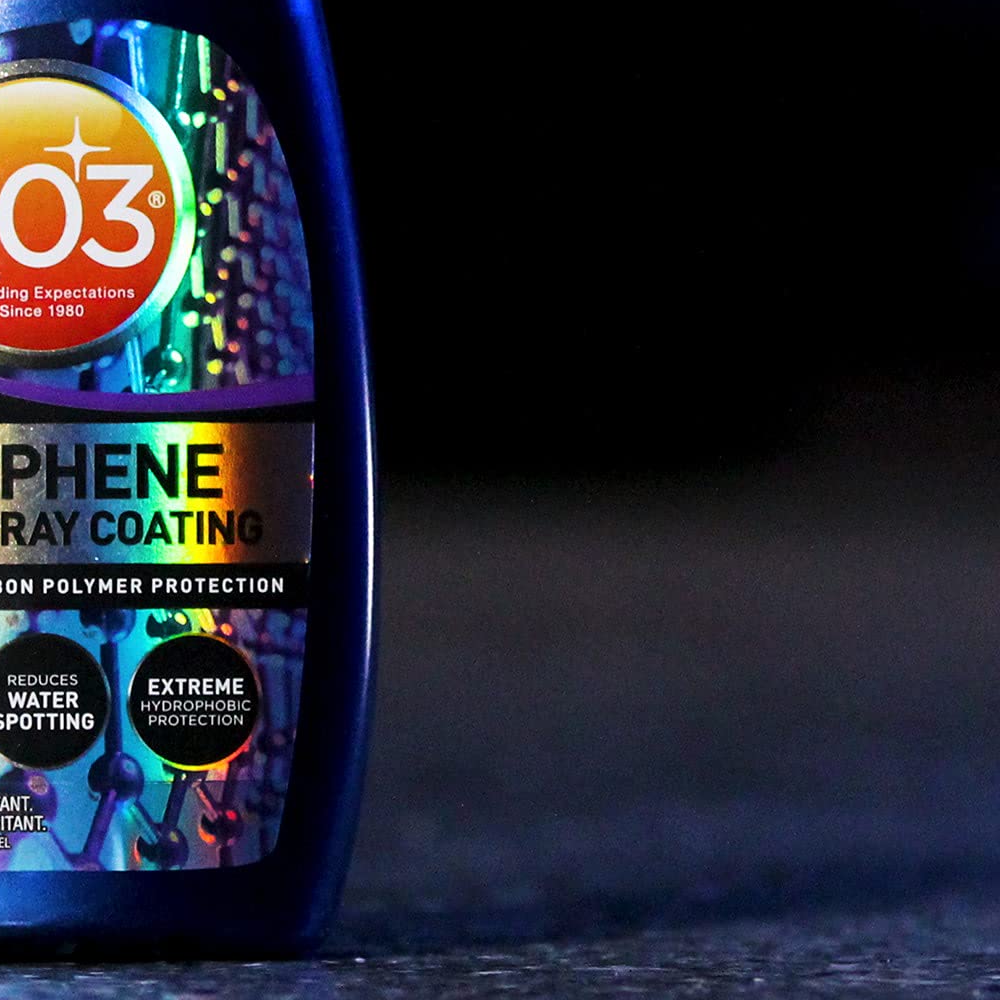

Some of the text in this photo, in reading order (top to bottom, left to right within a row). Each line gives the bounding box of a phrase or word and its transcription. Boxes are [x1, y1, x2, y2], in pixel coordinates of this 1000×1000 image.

[34, 286, 135, 301] Expectations
[0, 304, 84, 317] Since 1980
[90, 509, 263, 546] COATING
[42, 577, 143, 595] POLYMER
[151, 577, 284, 594] PROTECTION
[7, 674, 78, 687] REDUCES
[148, 678, 245, 695] EXTREME
[7, 691, 79, 709] WATER
[140, 700, 251, 712] HYDROPHOBIC
[148, 714, 244, 727] PROTECTION
